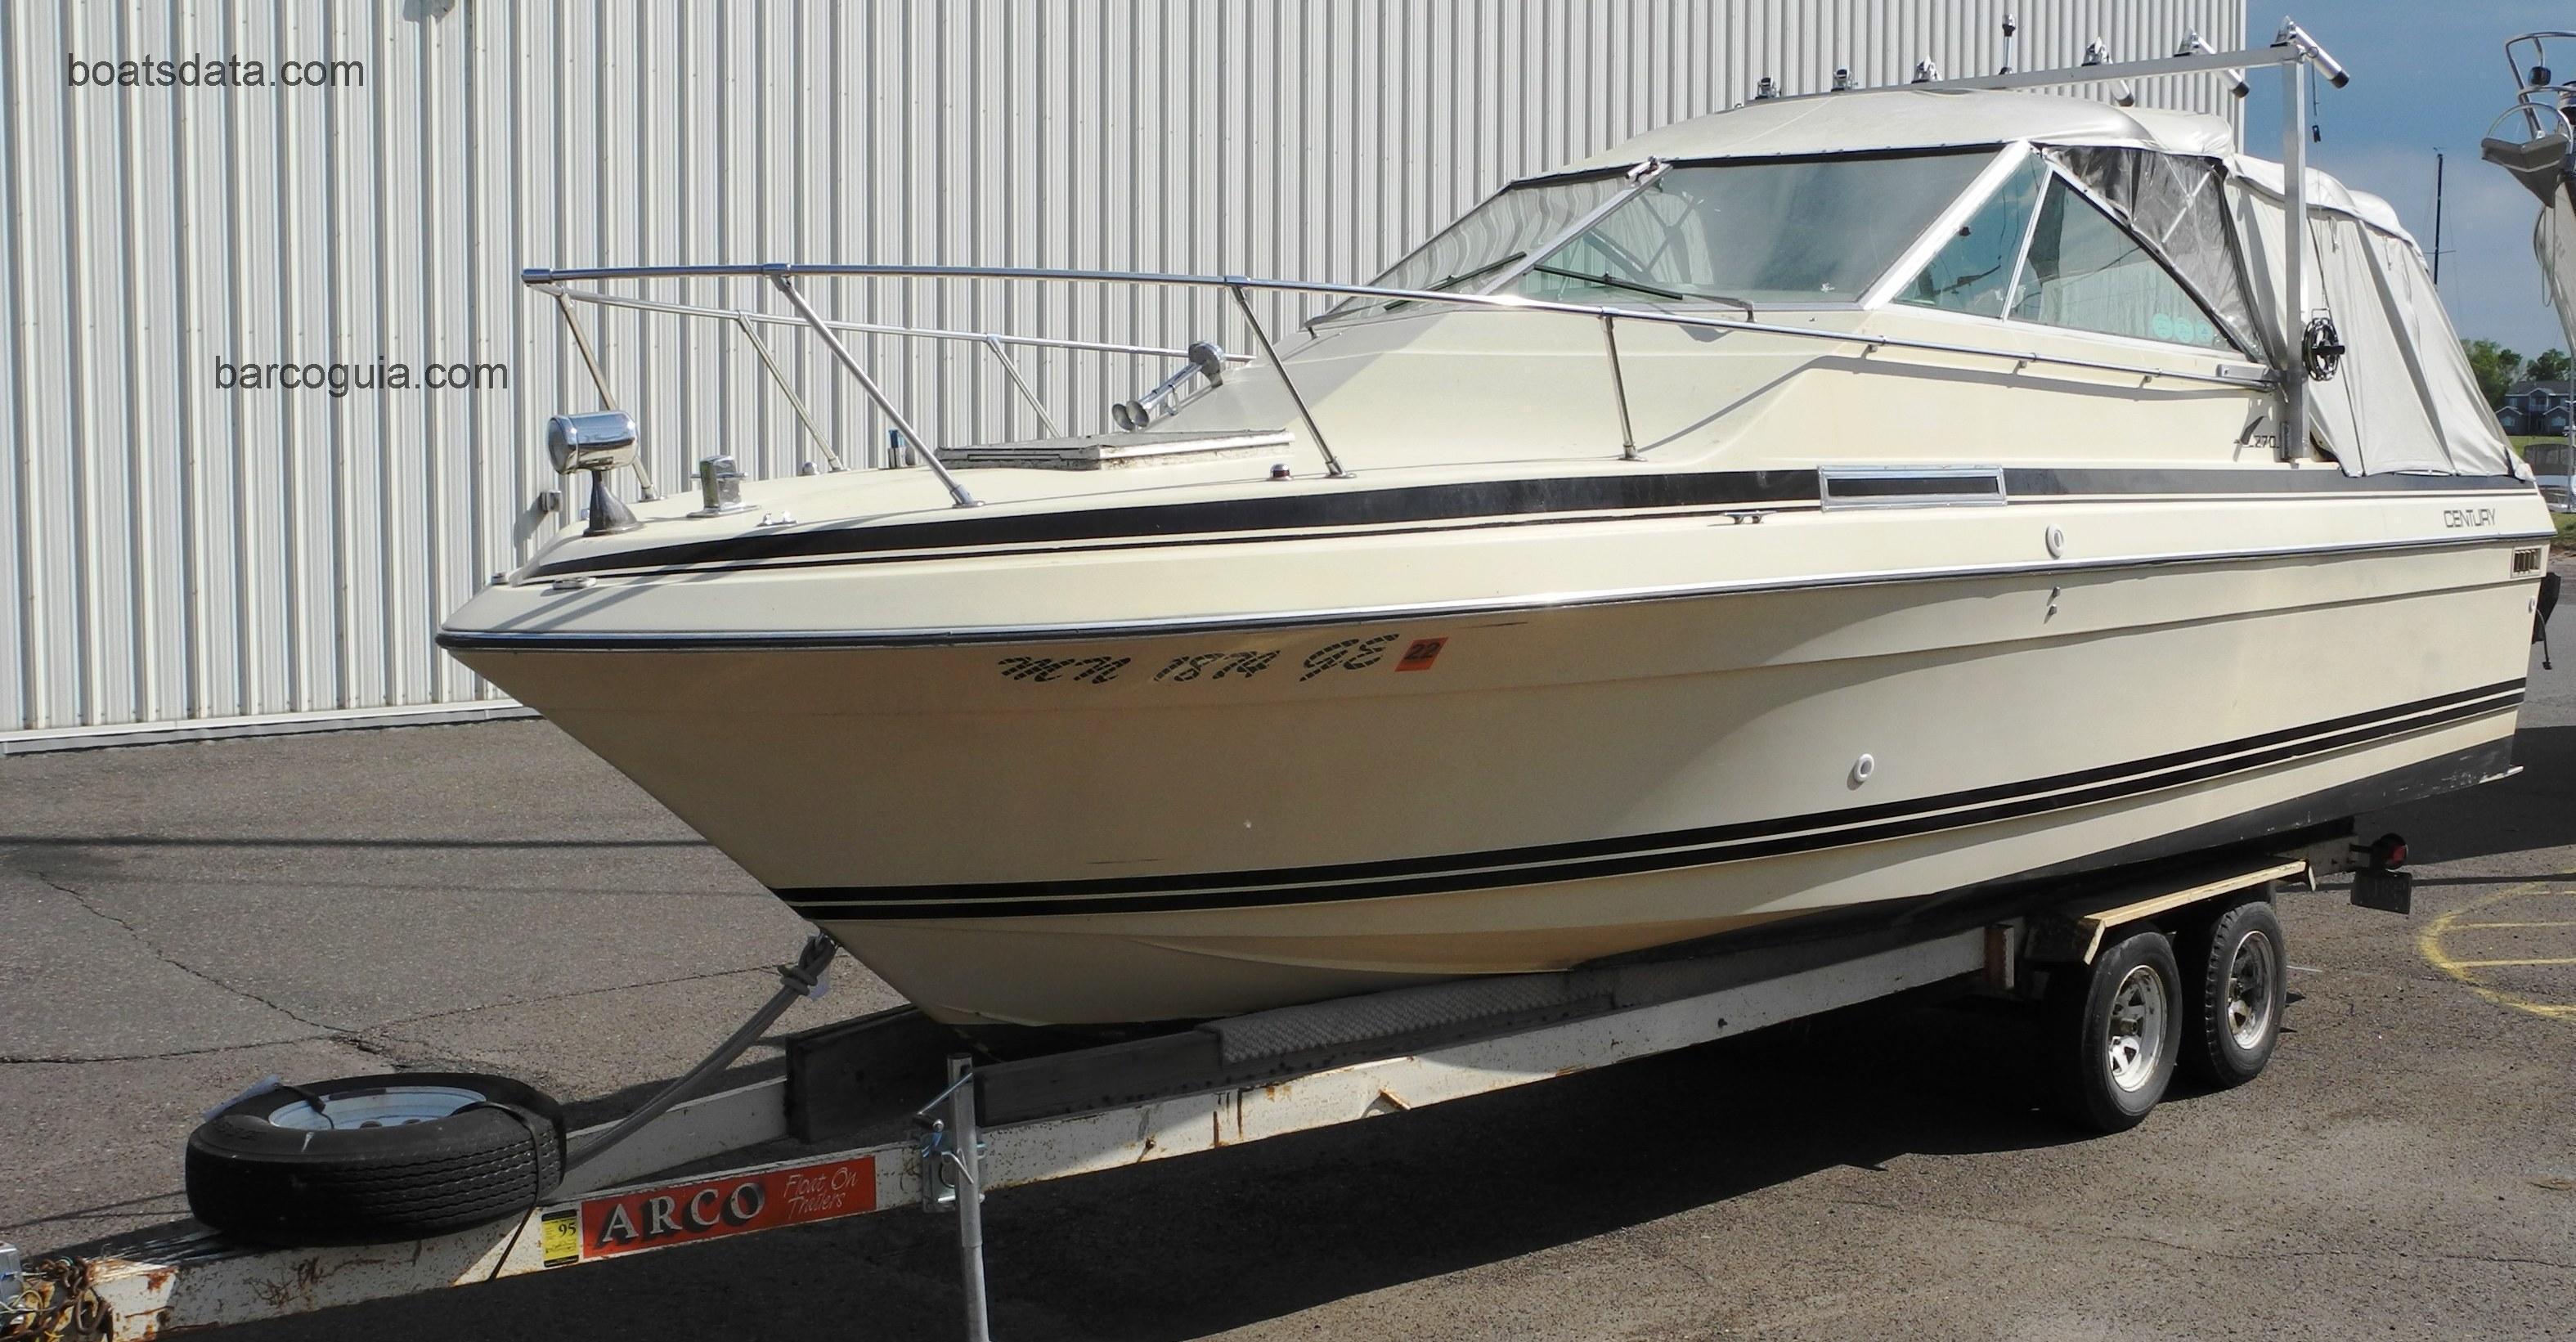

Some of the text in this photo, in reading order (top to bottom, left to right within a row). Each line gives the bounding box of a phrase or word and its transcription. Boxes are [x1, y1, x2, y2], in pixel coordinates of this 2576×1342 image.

[2444, 509, 2495, 527] CENTURY
[1404, 641, 1441, 660] 22
[1153, 649, 1281, 682] 1874
[783, 1166, 858, 1198] Float On
[600, 1182, 764, 1245] ARCO
[559, 1222, 577, 1237] 95
